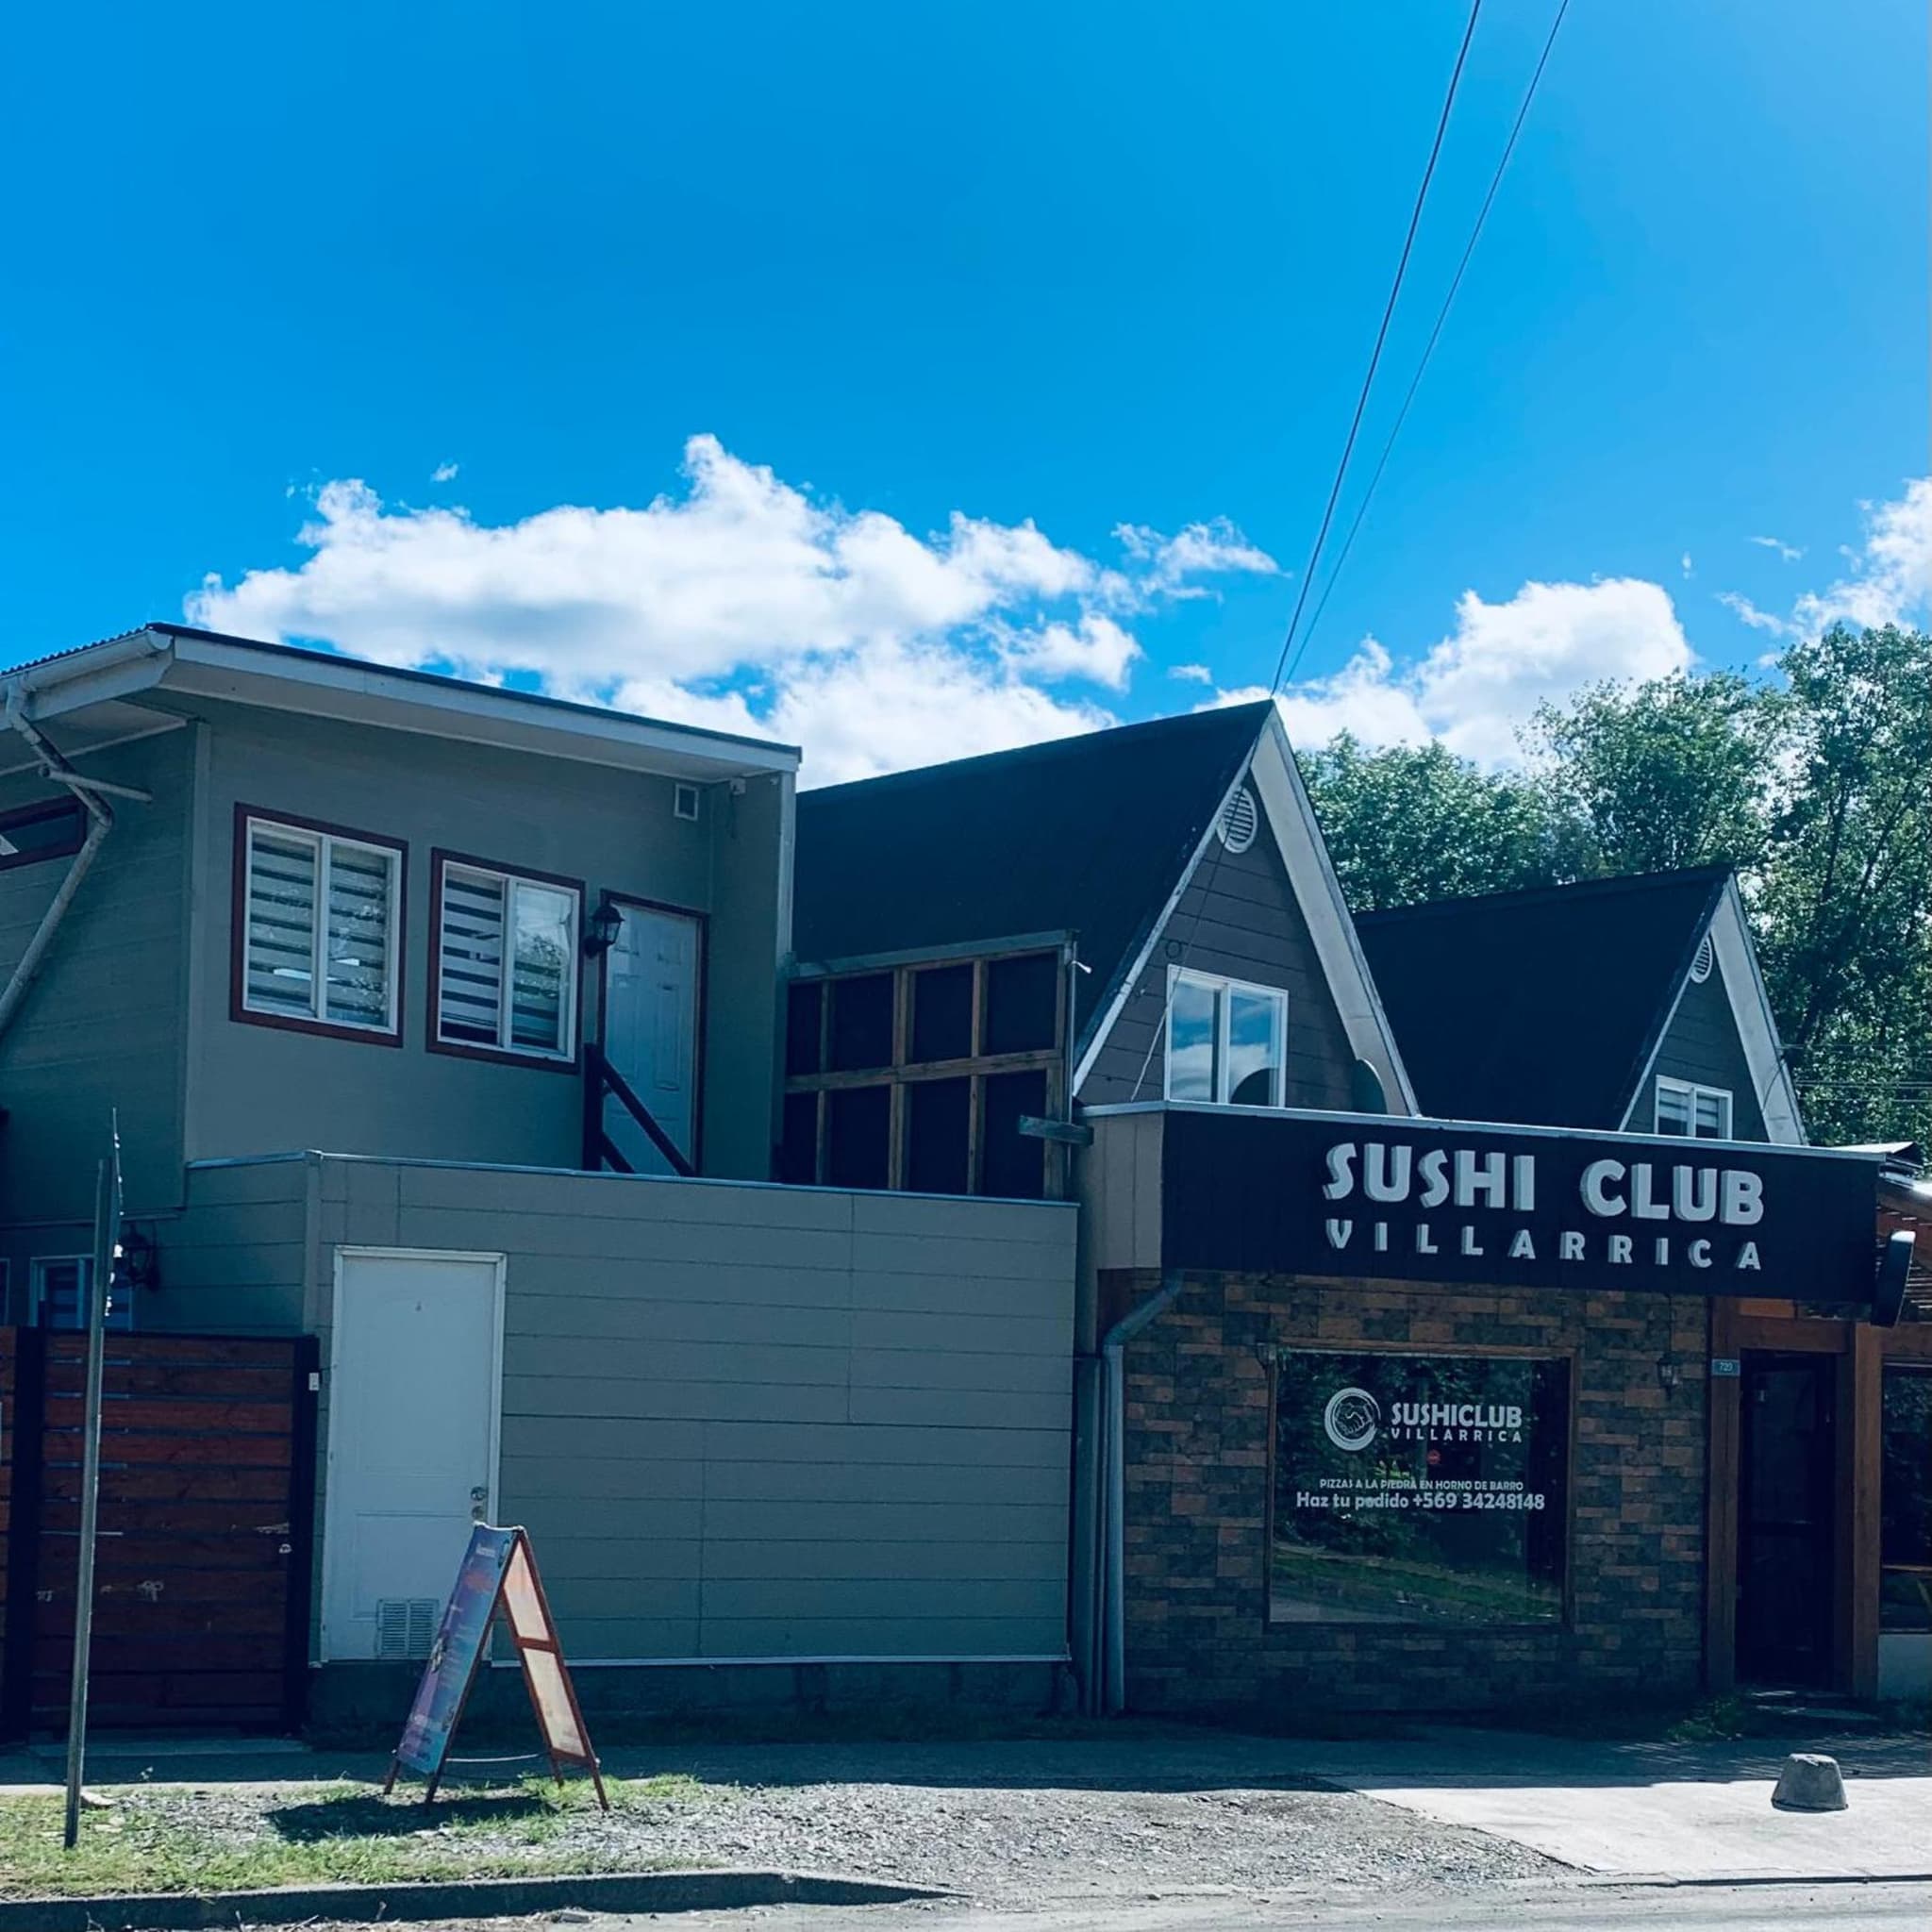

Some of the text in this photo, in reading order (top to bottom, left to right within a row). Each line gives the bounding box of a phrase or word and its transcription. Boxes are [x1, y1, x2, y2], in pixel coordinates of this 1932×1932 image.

[1323, 1142, 1764, 1225] SUSHI CLUB
[1325, 1219, 1761, 1271] VILLARRICA
[1391, 1403, 1523, 1428] SUSHICLUB
[1391, 1428, 1522, 1443] VILLARRICA
[1320, 1478, 1524, 1491] PIZZAS A LA PIEDRA EN HORNO DE BARRO
[1296, 1491, 1545, 1510] Haz tu pedido +569 34248148
